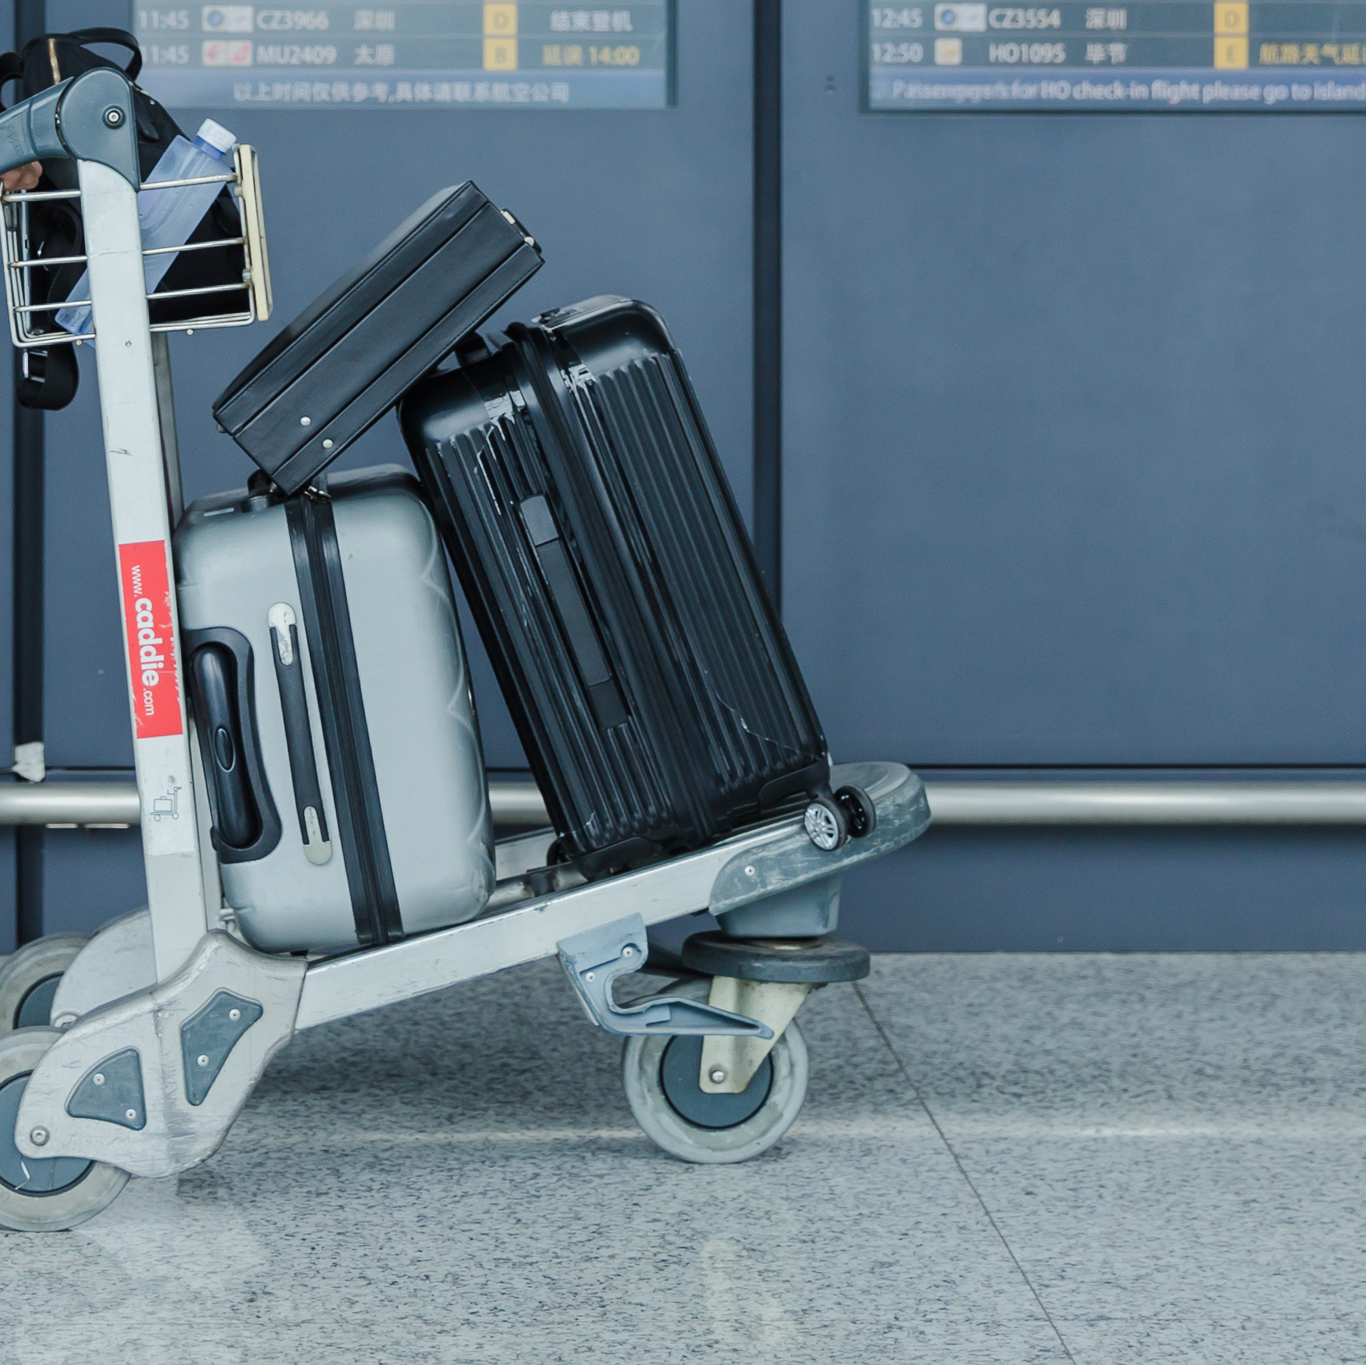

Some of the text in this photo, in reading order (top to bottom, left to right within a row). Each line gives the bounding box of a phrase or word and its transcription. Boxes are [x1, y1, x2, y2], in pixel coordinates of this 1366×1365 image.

[139, 10, 189, 28] 11:45
[256, 10, 329, 29] CZ3966
[355, 10, 394, 29] 深圳
[873, 8, 1126, 28] 12:45 CZ3554 深圳
[140, 45, 189, 63] 11:45
[256, 45, 337, 64] MU2409
[355, 44, 394, 64] 太原
[589, 46, 640, 65] 14:00
[873, 43, 923, 62] 12:50
[989, 43, 1065, 63] HO1095
[1041, 80, 1071, 100] HO
[1263, 85, 1289, 105] go
[1291, 82, 1311, 100] to
